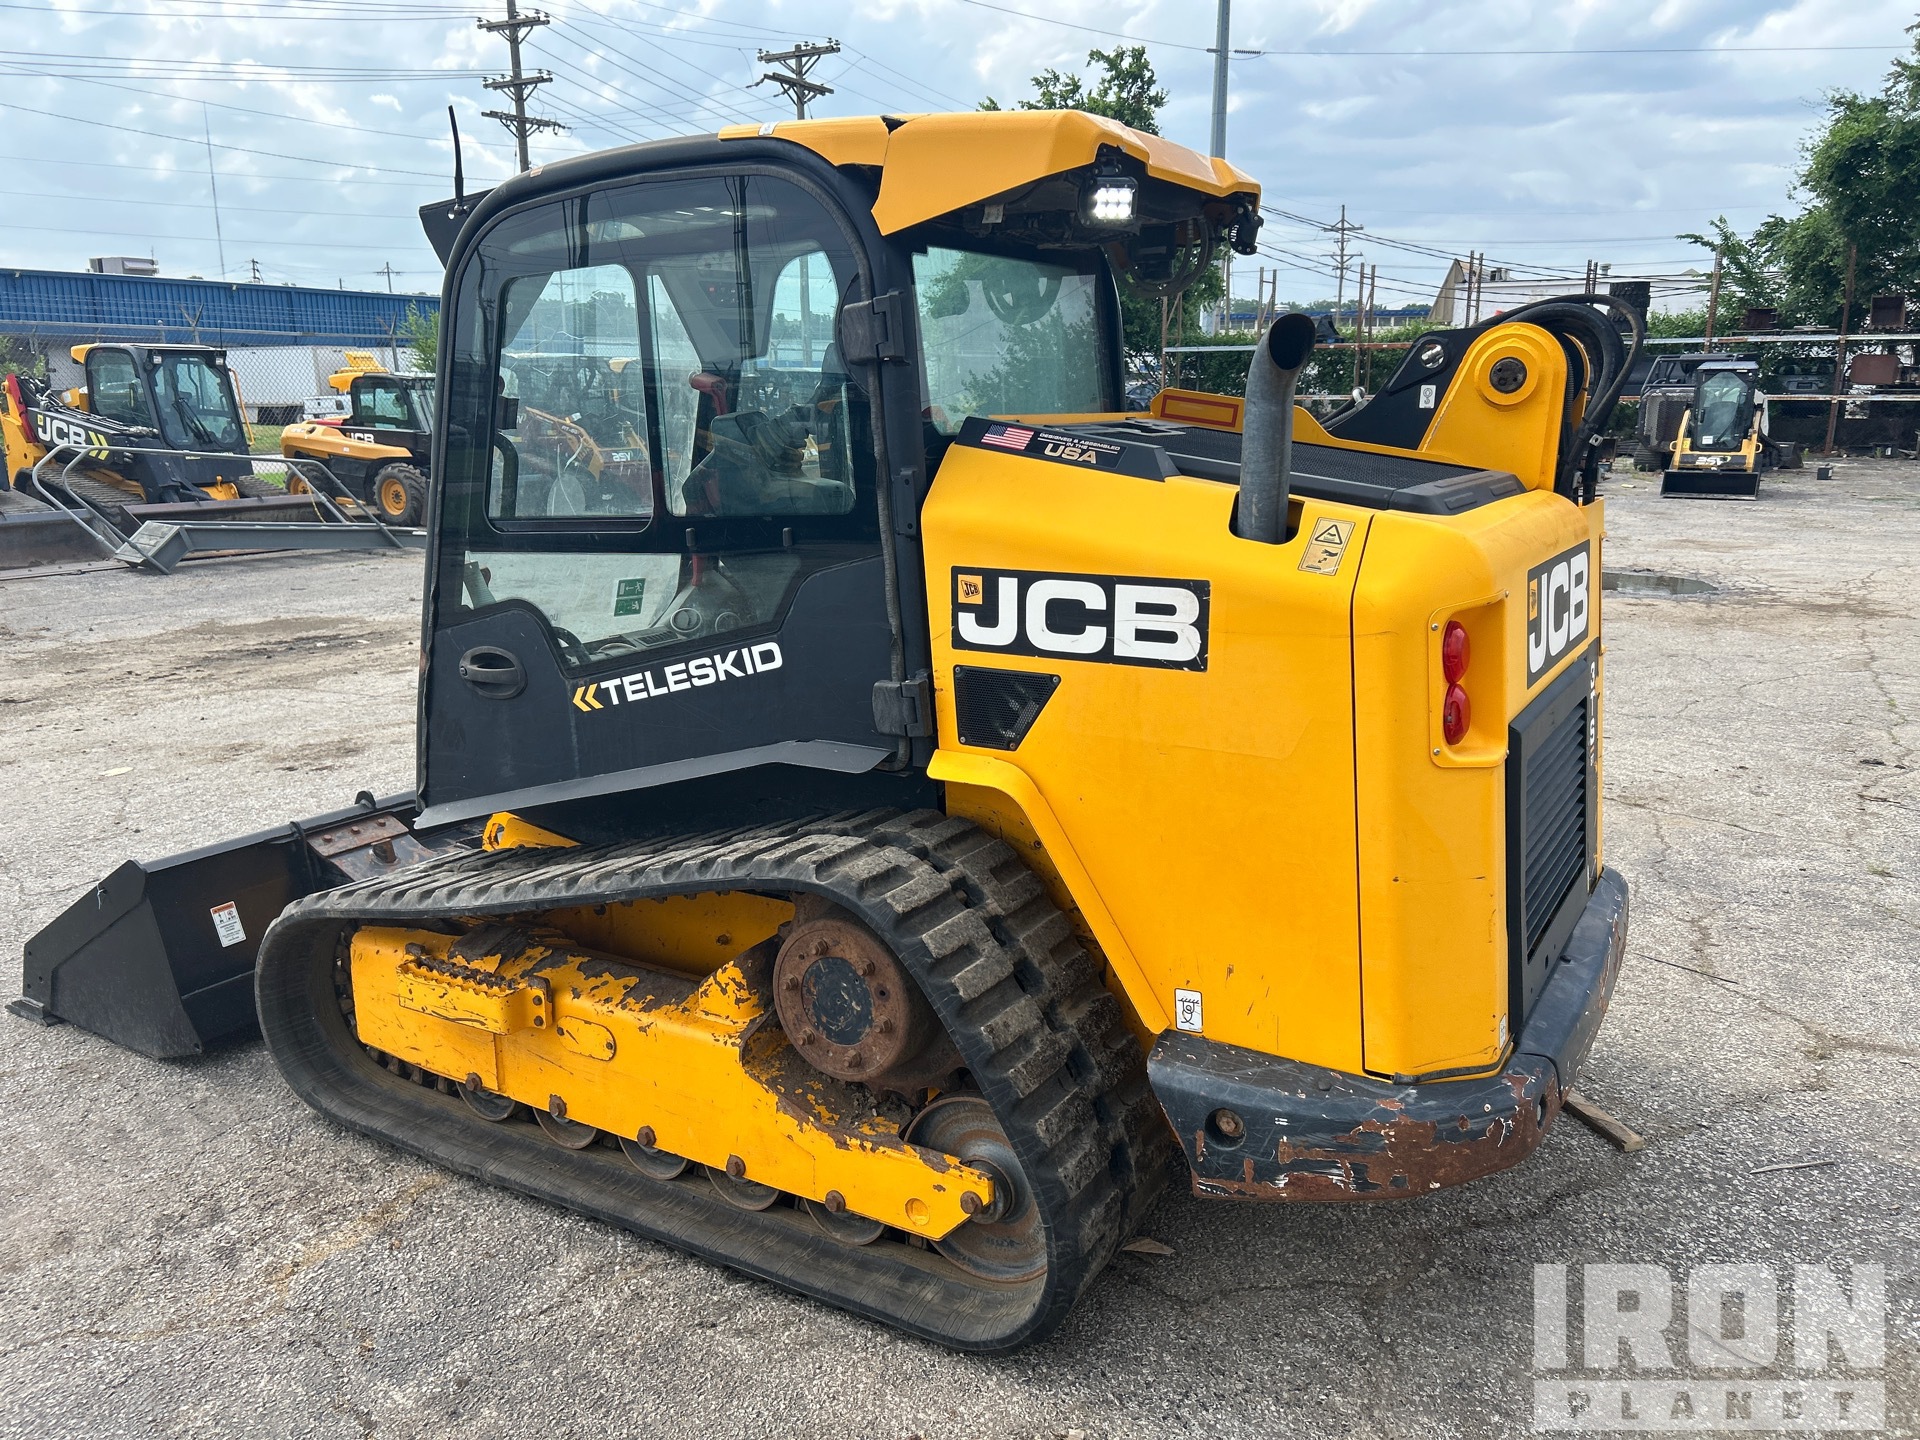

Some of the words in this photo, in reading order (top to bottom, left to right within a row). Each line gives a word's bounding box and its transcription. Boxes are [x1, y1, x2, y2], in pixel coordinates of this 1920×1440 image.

[38, 416, 86, 446] JCB
[1044, 443, 1097, 464] USA
[963, 581, 981, 597] JCB
[1529, 551, 1588, 674] JCB
[957, 576, 1201, 662] JCB
[600, 641, 783, 706] TELESKID
